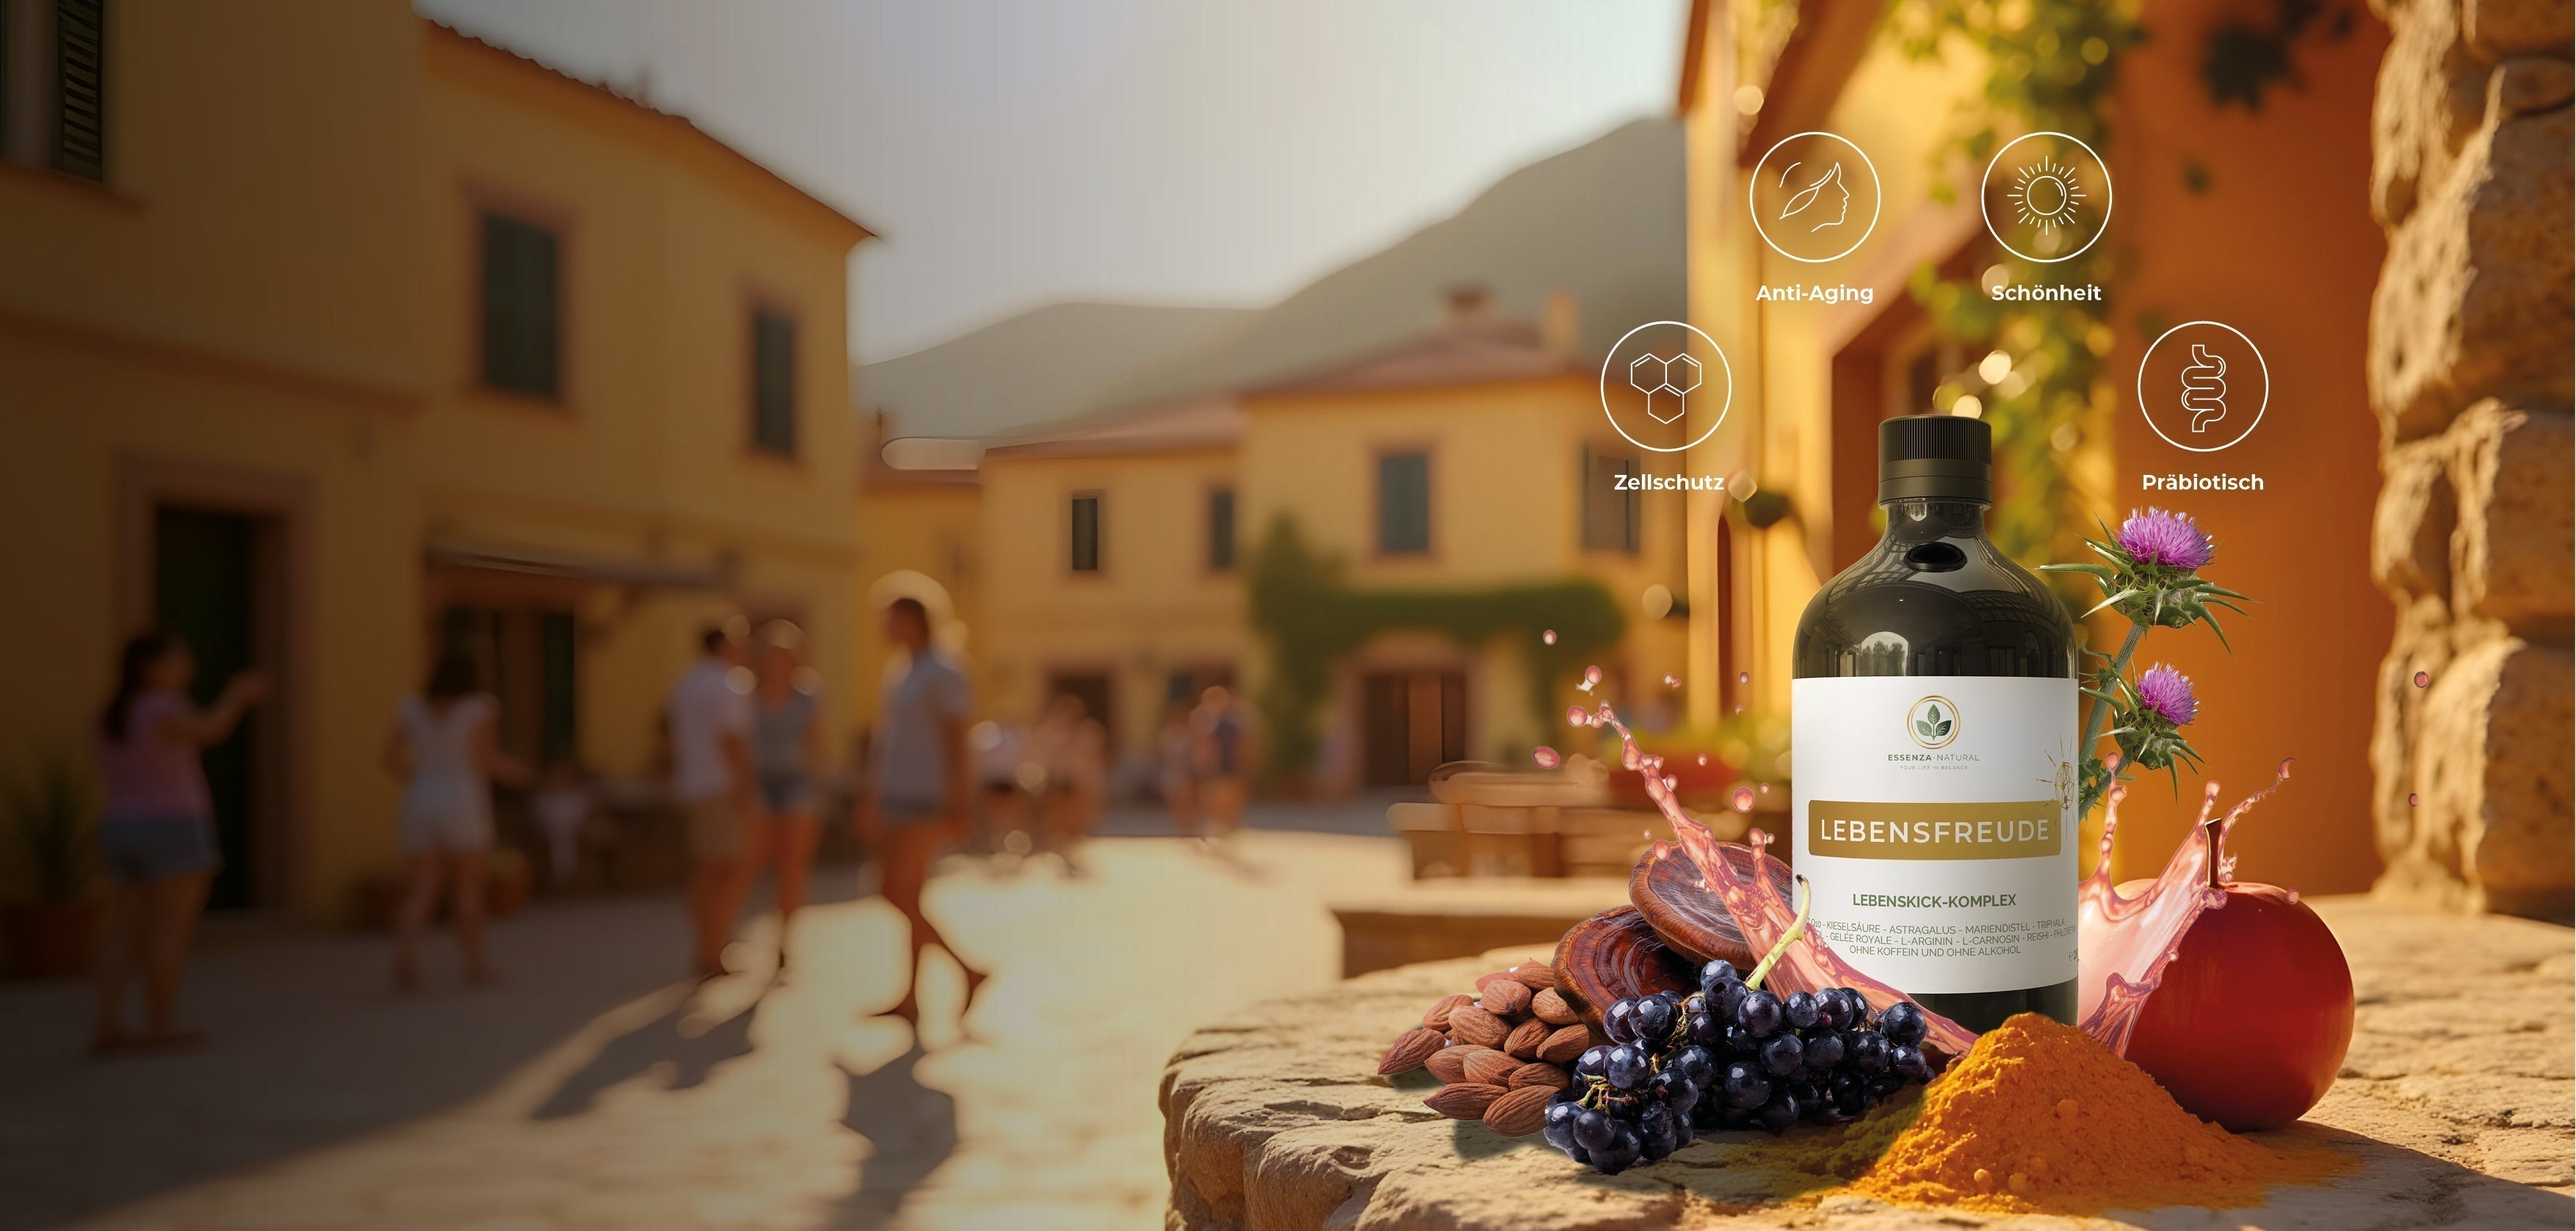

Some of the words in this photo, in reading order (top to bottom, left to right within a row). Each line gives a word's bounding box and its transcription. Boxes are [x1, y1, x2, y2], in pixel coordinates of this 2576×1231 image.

[1821, 819, 2049, 844] LEBENSFREUDE
[1853, 893, 2016, 908] LEBENSKICK-KOMPLEX
[1811, 919, 1821, 928] Q10
[1826, 921, 1880, 933] KIESELSÄURE
[1889, 926, 1956, 934] ASTRAGALUS
[1965, 923, 2030, 934] MARIENDISTEL
[1830, 932, 1854, 943] GELÉE
[1856, 934, 1892, 945] ROYALE
[1901, 937, 1953, 945] L-ARGININ
[1963, 935, 2020, 945] L-CARNOSIN
[2027, 932, 2049, 941] REISHI
[1850, 945, 1875, 955] OHNE
[1878, 947, 1918, 956] KOFFEIN
[1922, 948, 1944, 957] UND
[1947, 948, 1975, 957] OHNE
[1978, 945, 2021, 956] ALKOHOL
